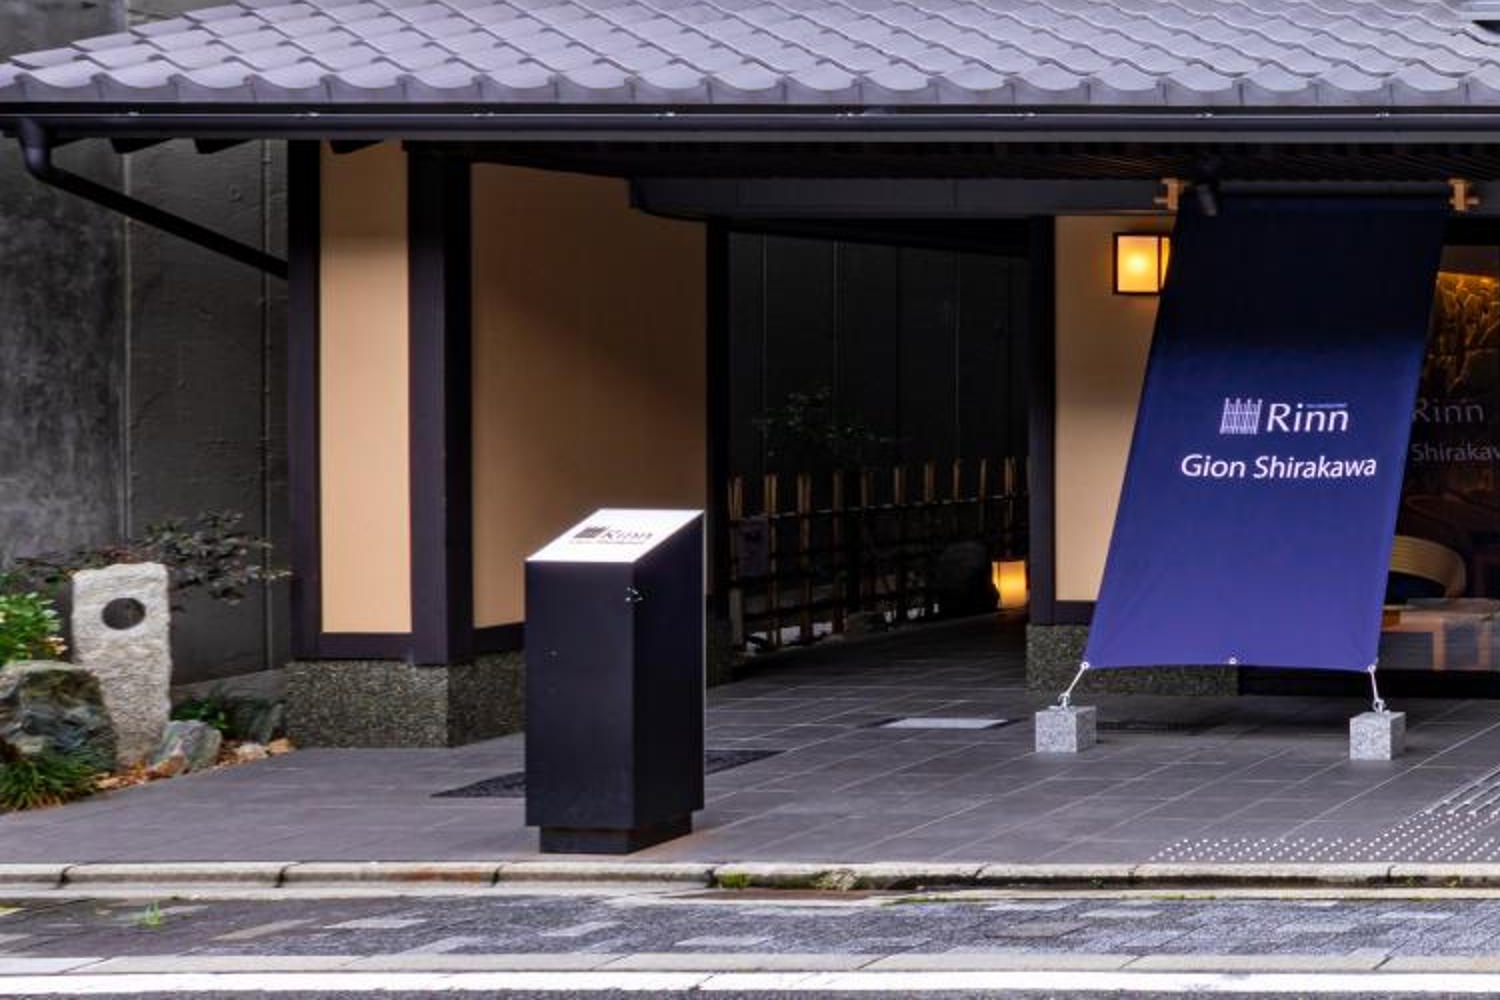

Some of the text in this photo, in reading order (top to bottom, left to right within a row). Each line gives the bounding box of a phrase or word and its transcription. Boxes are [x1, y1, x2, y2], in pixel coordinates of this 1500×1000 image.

[1267, 402, 1349, 433] Rinn
[1181, 454, 1377, 479] Gion Shirakawa
